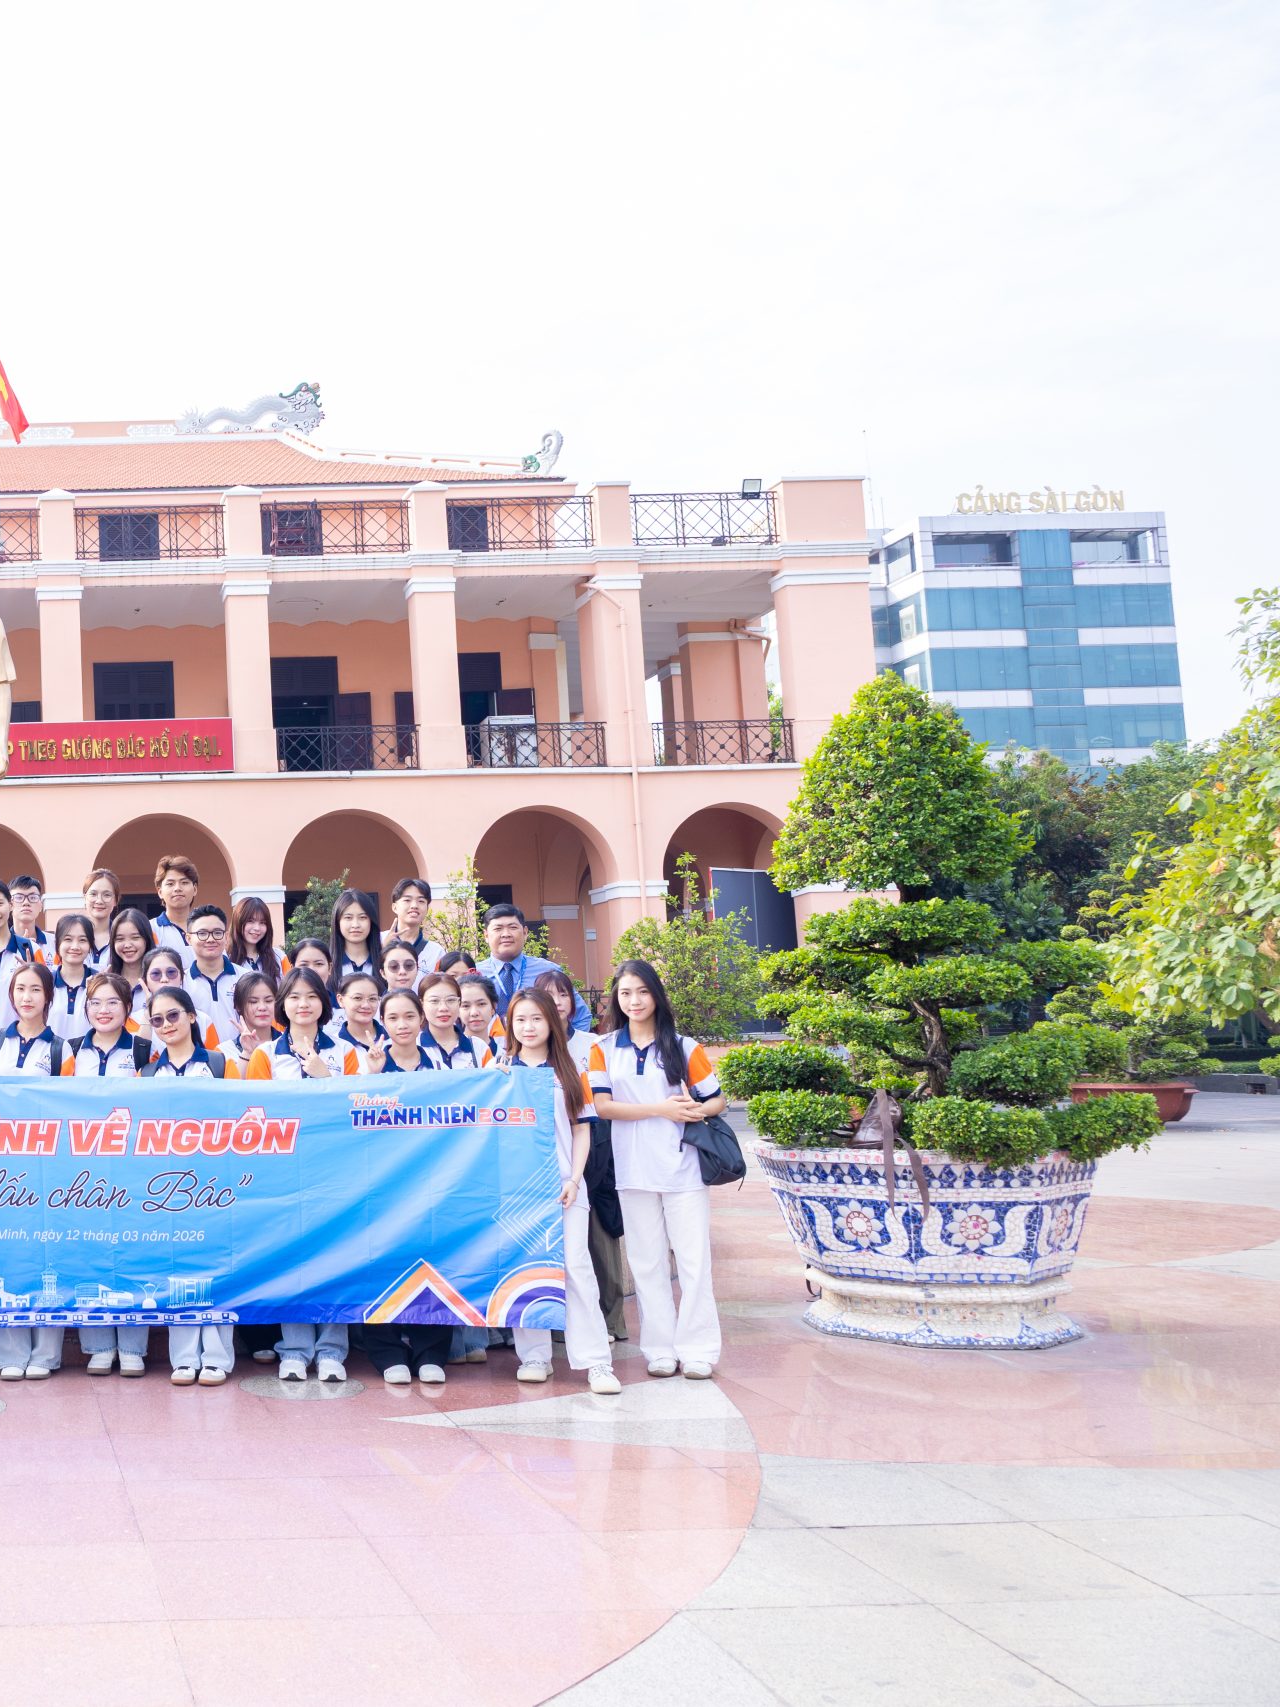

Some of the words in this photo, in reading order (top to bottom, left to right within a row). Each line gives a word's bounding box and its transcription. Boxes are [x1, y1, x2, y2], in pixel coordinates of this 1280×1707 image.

[957, 485, 1021, 513] CẢNG
[1028, 486, 1066, 512] SÀI
[1075, 485, 1124, 511] GÒN
[18, 739, 56, 761] THEO
[116, 731, 146, 758] BÁC
[351, 1106, 422, 1127] THANH
[428, 1103, 476, 1125] NIÊN
[478, 1107, 536, 1123] 2026
[68, 1107, 132, 1157] VỀ
[133, 1106, 301, 1157] NGUỒN
[47, 1170, 131, 1209] chân
[33, 1229, 63, 1243] ngày
[66, 1229, 80, 1241] 12
[83, 1229, 119, 1244] tháng
[122, 1230, 138, 1242] 03
[141, 1230, 169, 1242] năm
[172, 1230, 205, 1242] 2026
